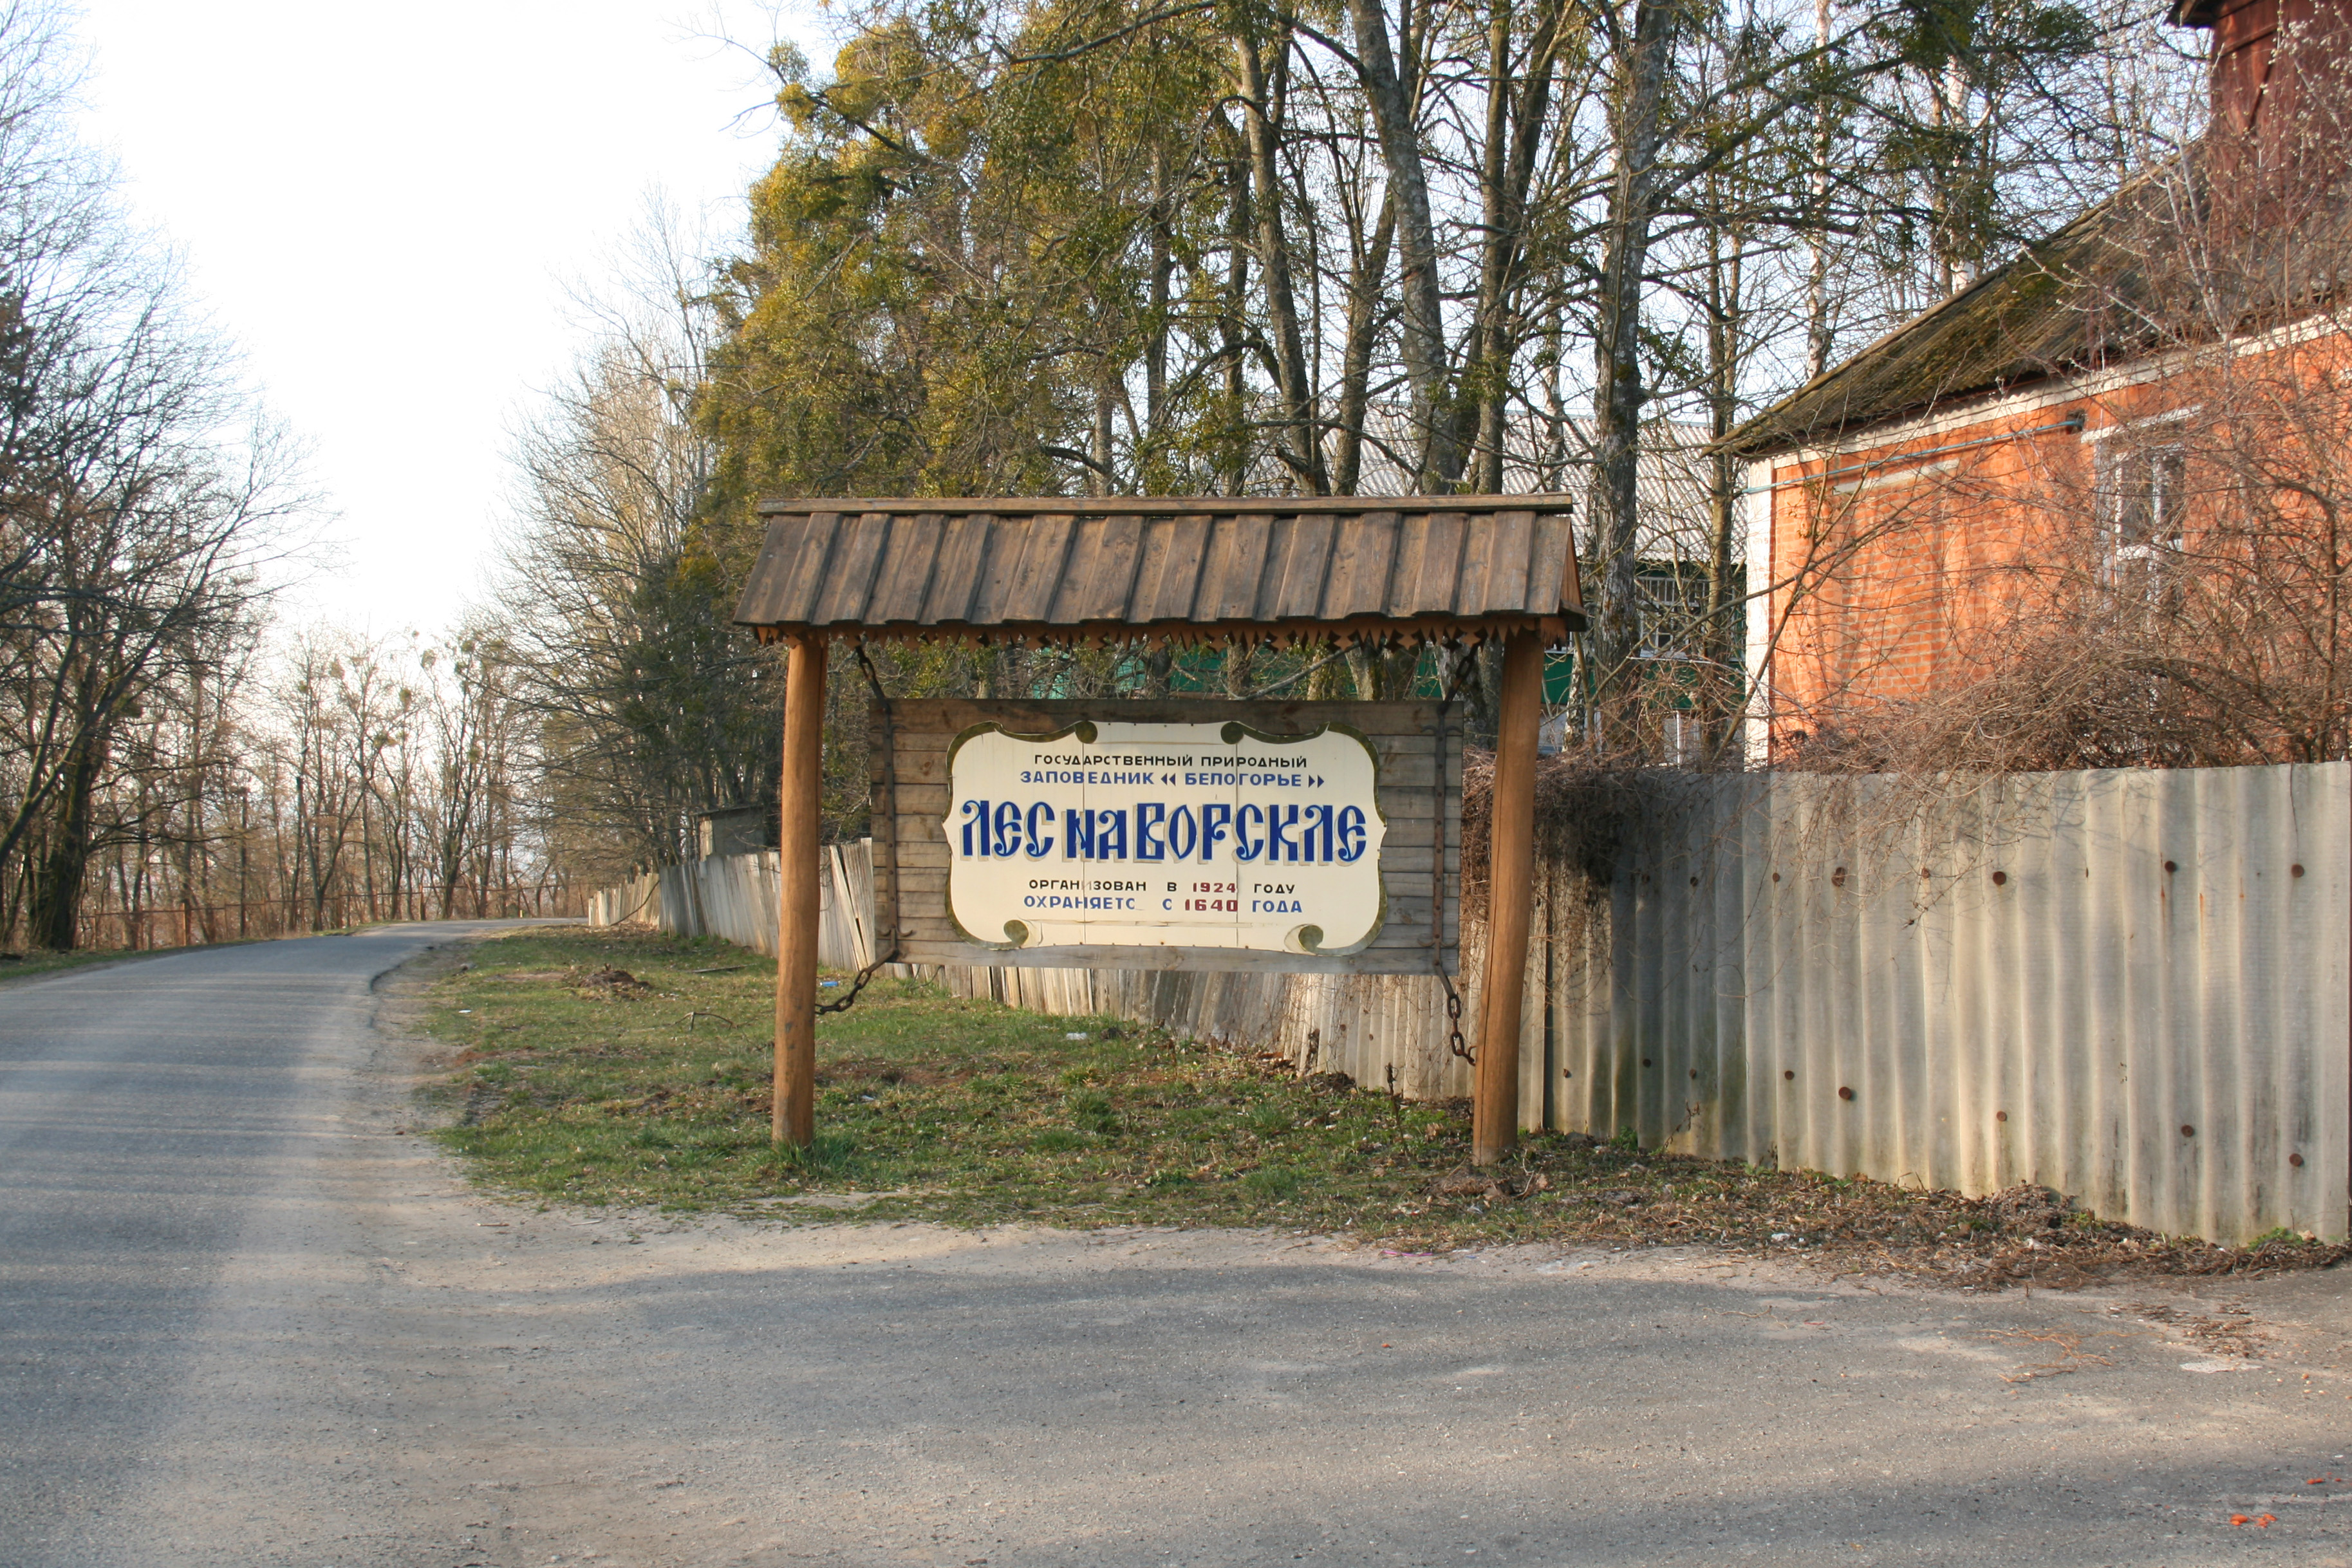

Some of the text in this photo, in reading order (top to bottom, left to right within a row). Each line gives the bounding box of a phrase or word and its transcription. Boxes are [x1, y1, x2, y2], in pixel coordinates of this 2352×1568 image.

[1034, 754, 1307, 768] ГОСУДАРСТВЕННЫЙ ПРИРОДНЫЙ
[1020, 771, 1155, 785] ЗАПОВЕДНИК
[961, 800, 1056, 857] ЛЕС
[1136, 802, 1367, 863] ВОРСКЛЕ
[1029, 879, 1295, 894] ОРГАНИЗОВАН В 1924 ГОДУ
[1162, 899, 1173, 911] С
[1184, 899, 1238, 912] 1640
[1252, 901, 1303, 913] ГОДА
